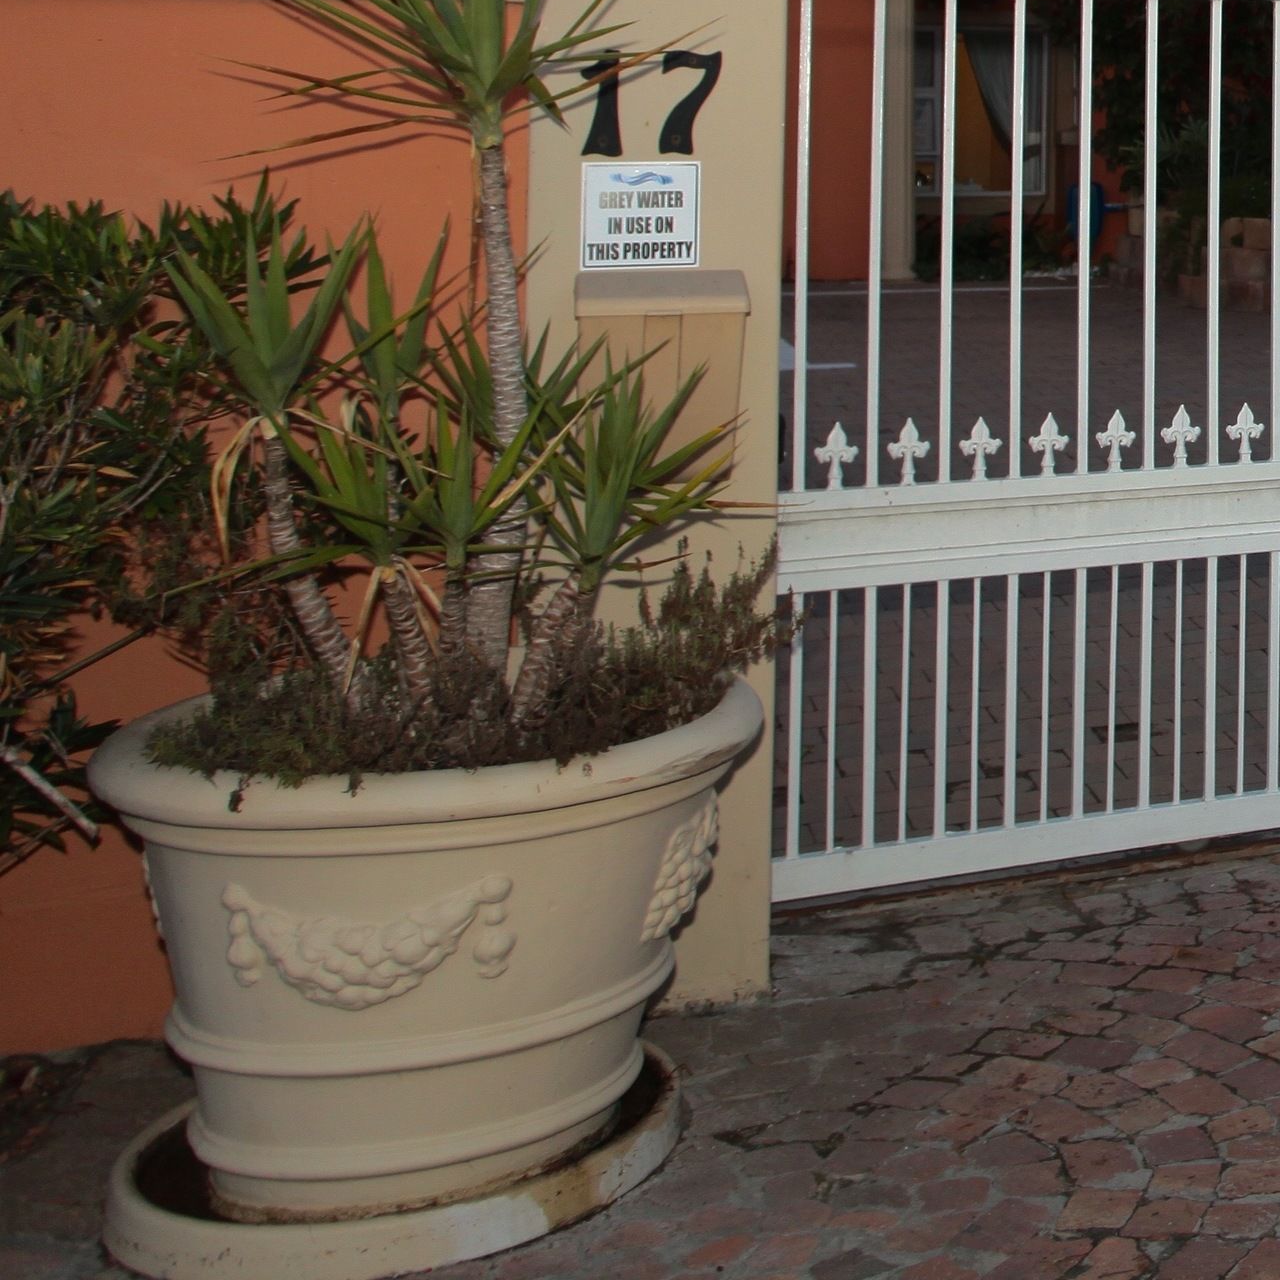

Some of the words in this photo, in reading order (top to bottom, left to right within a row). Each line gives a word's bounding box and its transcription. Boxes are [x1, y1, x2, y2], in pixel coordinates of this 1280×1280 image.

[581, 49, 722, 157] 17
[599, 191, 635, 209] GREY
[637, 191, 683, 208] WATER
[608, 217, 622, 235] IN
[626, 216, 652, 234] USE
[655, 216, 674, 233] ON
[587, 242, 619, 261] THIS
[623, 241, 693, 260] PROPERTY
